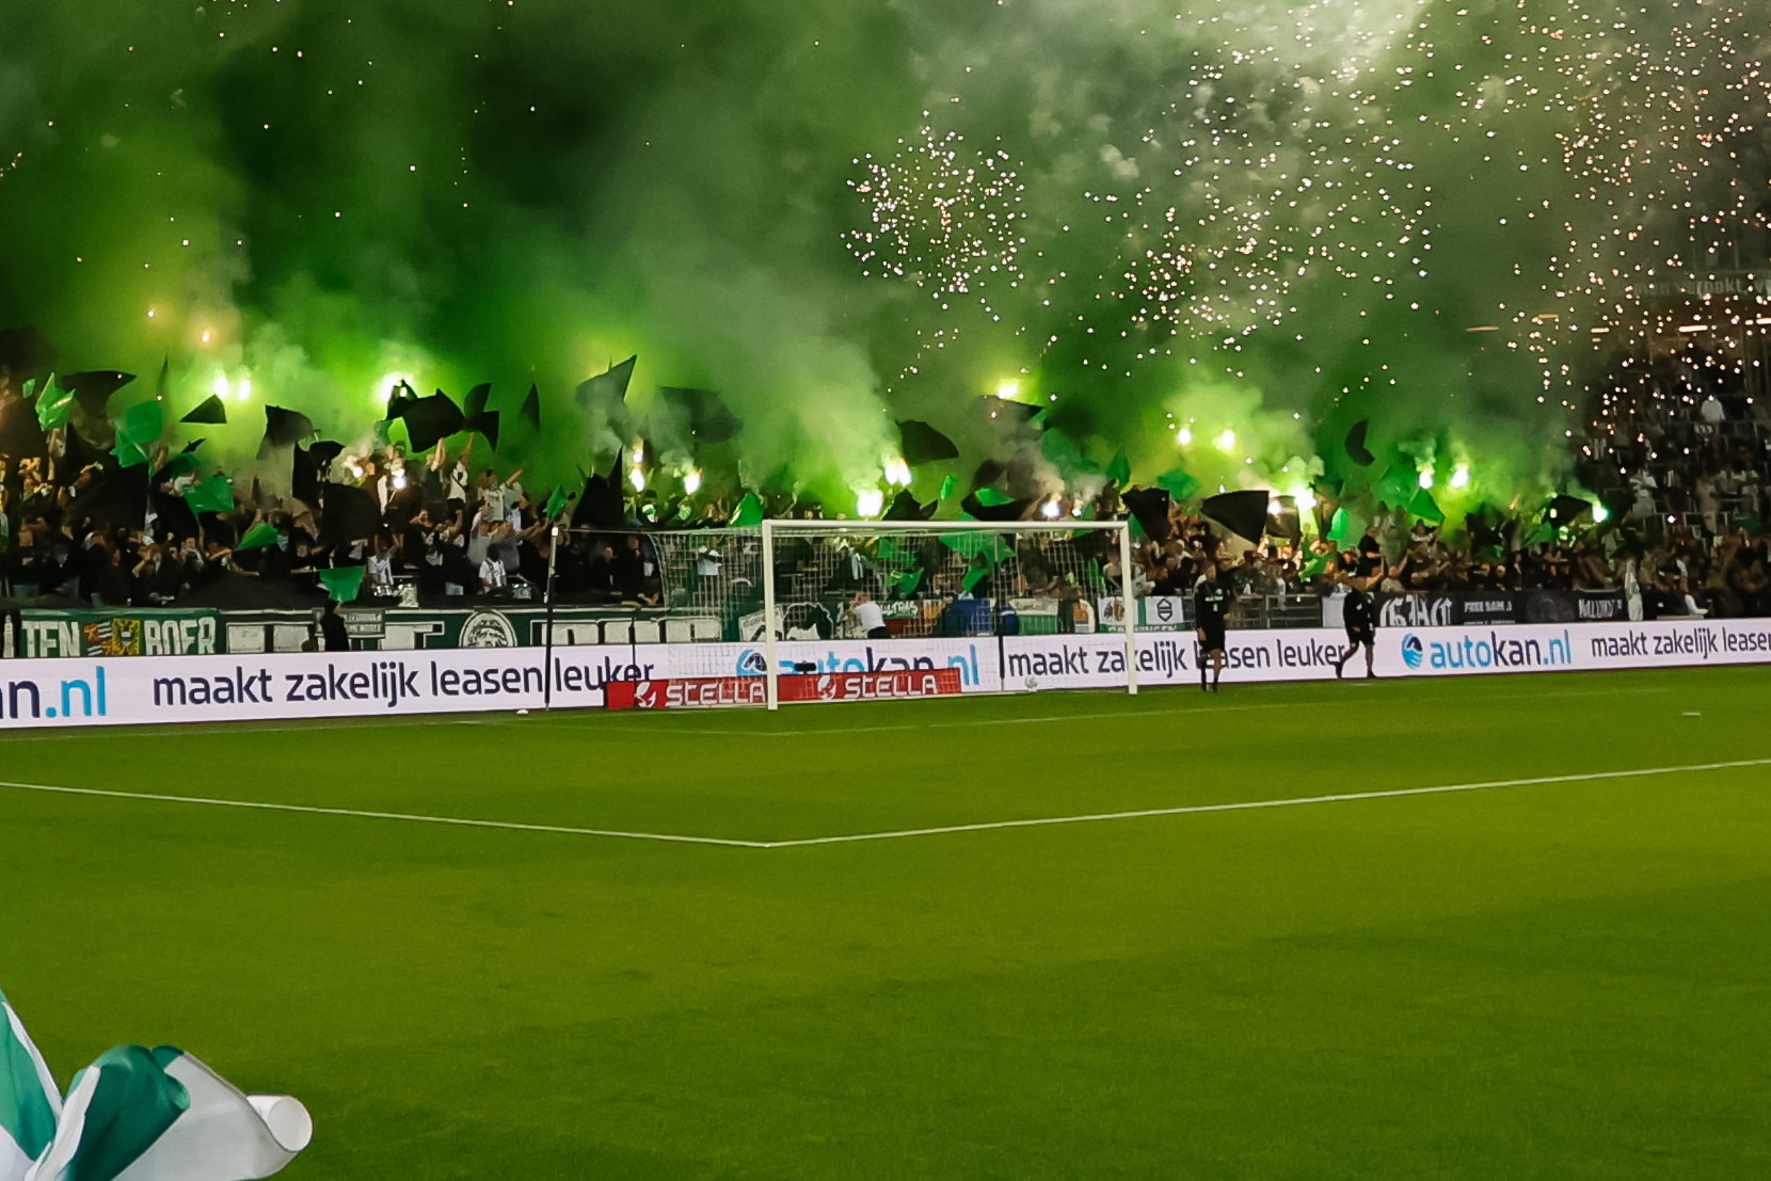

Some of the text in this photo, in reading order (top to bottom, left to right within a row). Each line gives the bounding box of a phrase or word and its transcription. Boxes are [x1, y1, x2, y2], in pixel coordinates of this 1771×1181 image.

[1008, 644, 1090, 677] maakt
[1276, 637, 1345, 667] leuker
[1429, 629, 1572, 669] autokan.nl
[1590, 630, 1649, 657] maakt
[1653, 626, 1718, 660] zakelijk
[153, 655, 655, 708] maakt zakelijk leasen leuker
